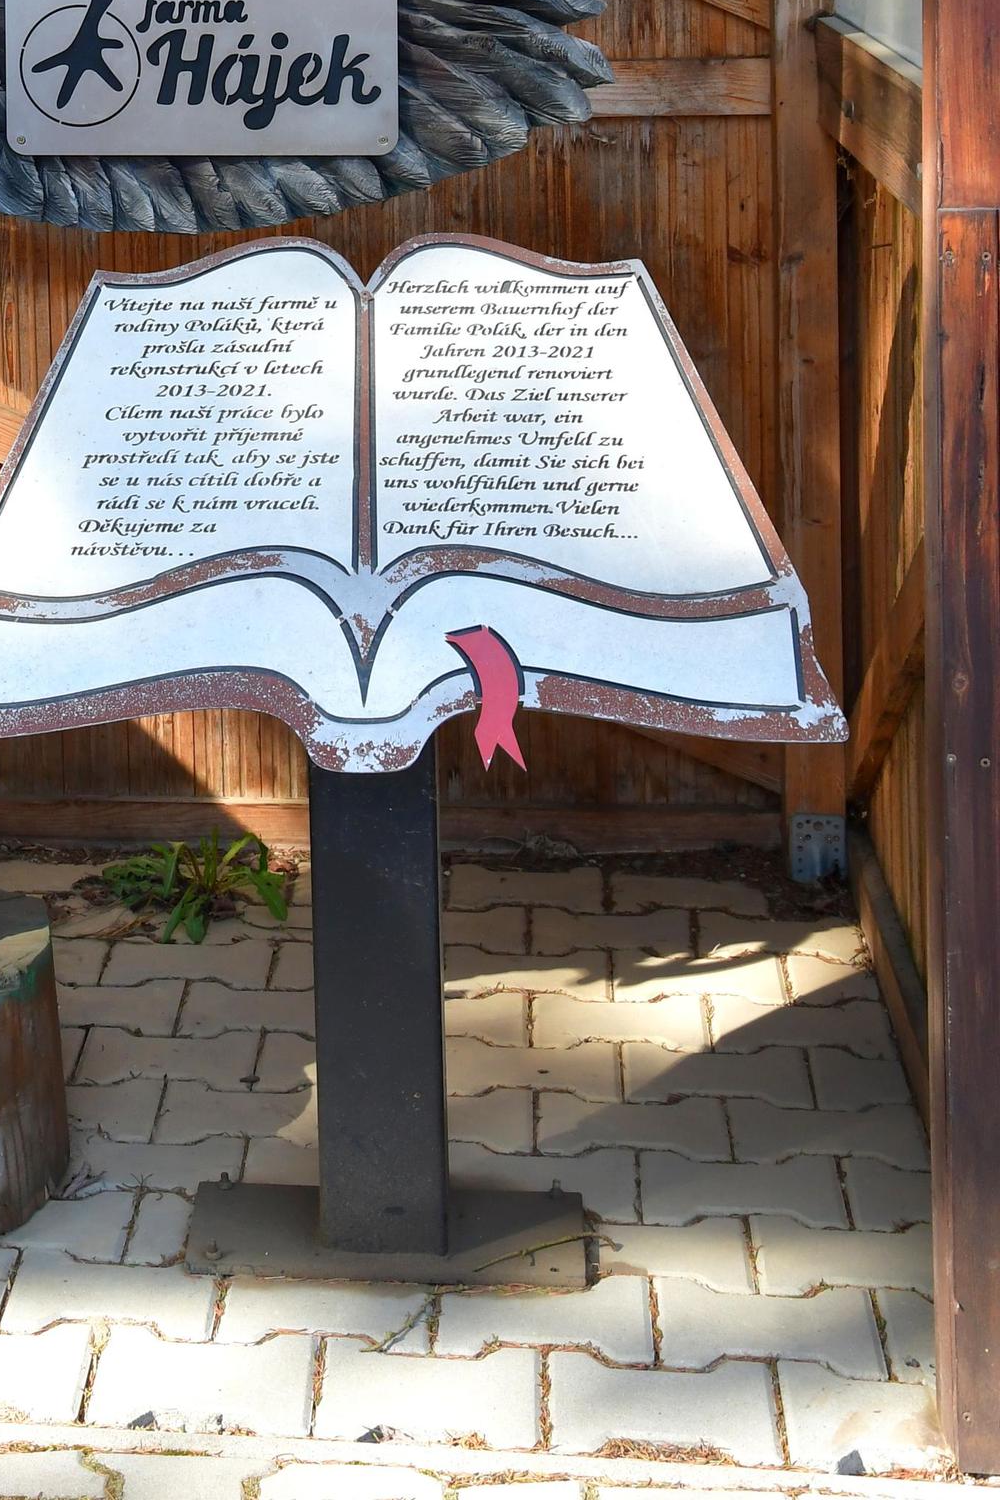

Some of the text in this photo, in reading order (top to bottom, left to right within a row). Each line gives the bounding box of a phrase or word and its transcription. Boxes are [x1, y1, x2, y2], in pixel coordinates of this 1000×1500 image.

[146, 29, 381, 130] Hájek
[387, 280, 632, 298] Herzlich willkommen auf
[104, 296, 337, 315] Vítejte na naší farmě u
[400, 302, 619, 320] unserem Bauernhof der
[115, 318, 324, 336] rodiny Poláků, která
[390, 322, 461, 335] Familie
[534, 324, 568, 336] der
[570, 324, 587, 336] in
[595, 324, 628, 336] den
[141, 340, 294, 358] prošla zásadní
[420, 343, 594, 359] Jahren 2013-2021
[110, 360, 323, 378] rekonstrukcí v letech
[402, 365, 613, 383] grundlegend renoviert
[155, 384, 272, 397] 2013-2021.
[392, 387, 628, 402] wurde. Das Ziel unserer
[105, 404, 324, 423] Cílem naší práce bylo
[432, 408, 583, 425] Arbeit war, ein
[122, 428, 303, 446] vytvořit příjemné
[396, 431, 623, 449] angenehmes Umfeld zu
[82, 450, 340, 468] prostředí tak aby se jste
[379, 452, 644, 471] schaffen, damit Sie sich bei
[99, 472, 322, 487] se u nás cítili dobře a
[384, 474, 639, 495] uns wohlfühlen und gerne
[97, 494, 320, 513] rádi se k nám vraceli.
[556, 500, 620, 515] Vielen
[78, 518, 216, 537] Děkujeme za
[383, 521, 447, 539] Dank
[440, 521, 479, 539] für
[482, 522, 538, 536] Ihren
